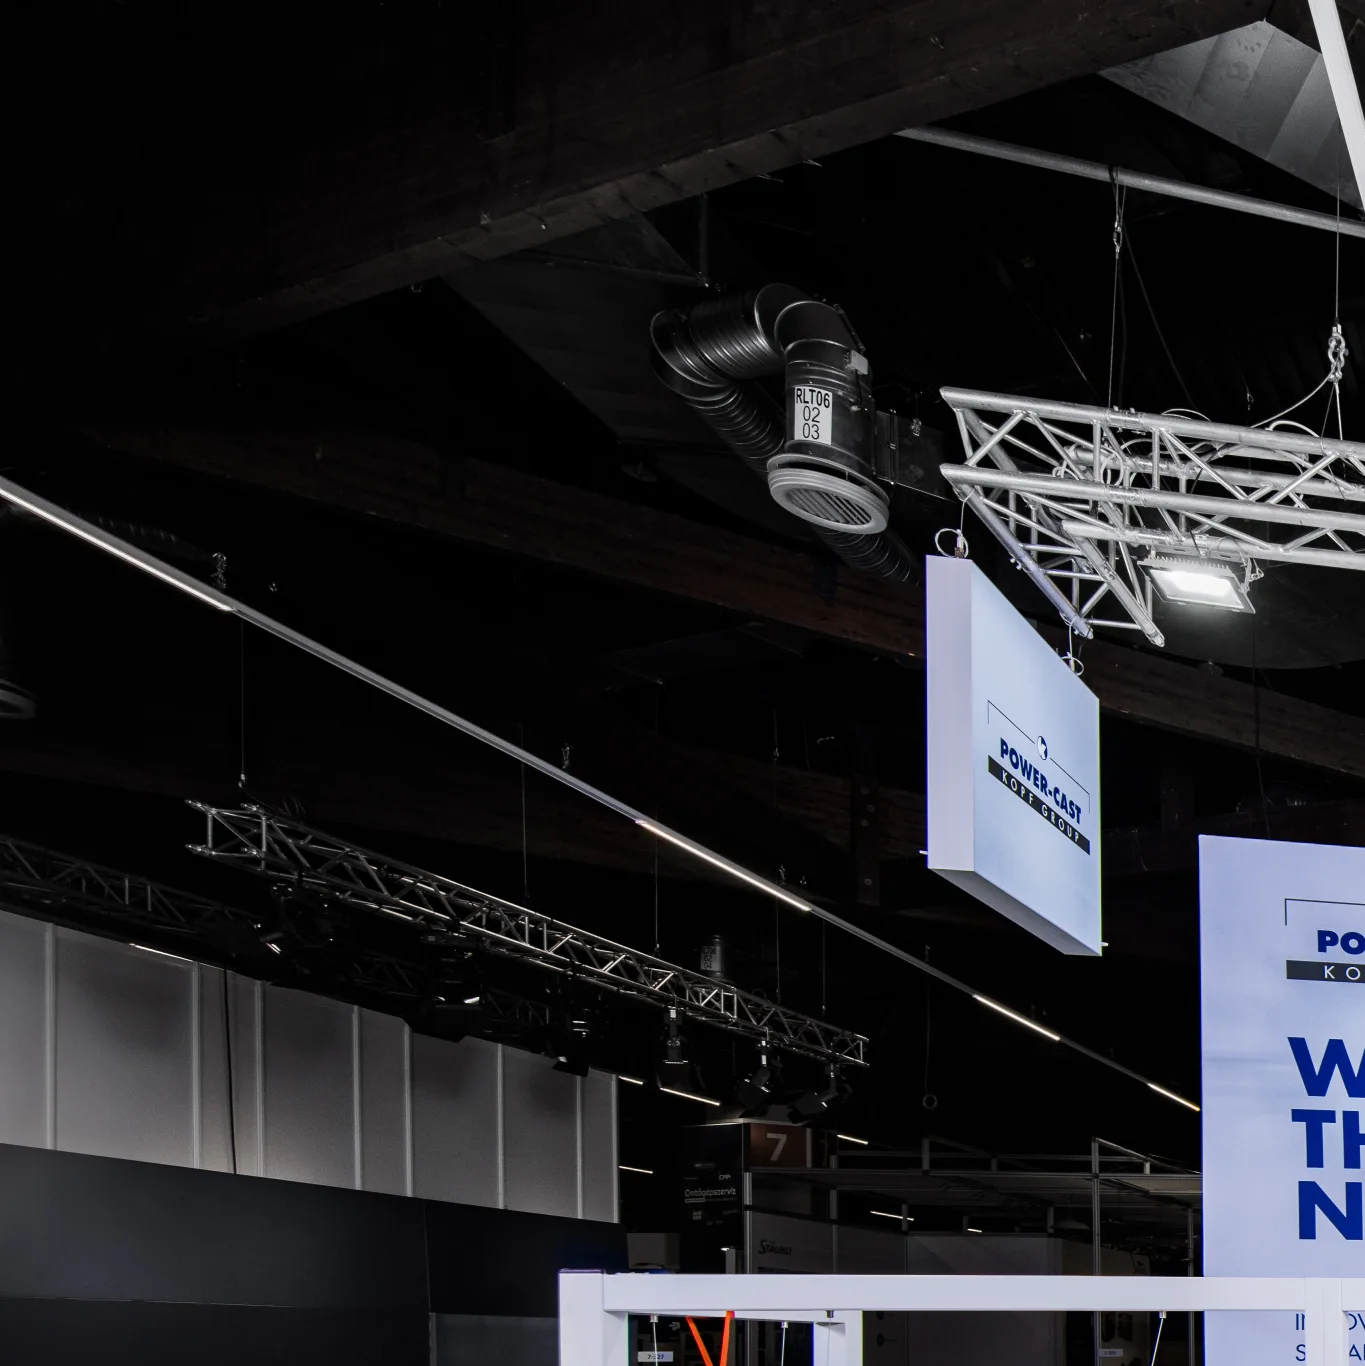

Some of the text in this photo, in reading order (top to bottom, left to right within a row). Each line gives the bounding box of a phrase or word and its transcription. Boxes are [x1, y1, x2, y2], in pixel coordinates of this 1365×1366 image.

[796, 388, 830, 408] RLT06
[803, 405, 820, 423] 02
[803, 423, 820, 440] 03
[1000, 737, 1082, 824] POWER-CAST
[1002, 769, 1080, 842] KOPF GROUP
[767, 1132, 787, 1161] 7
